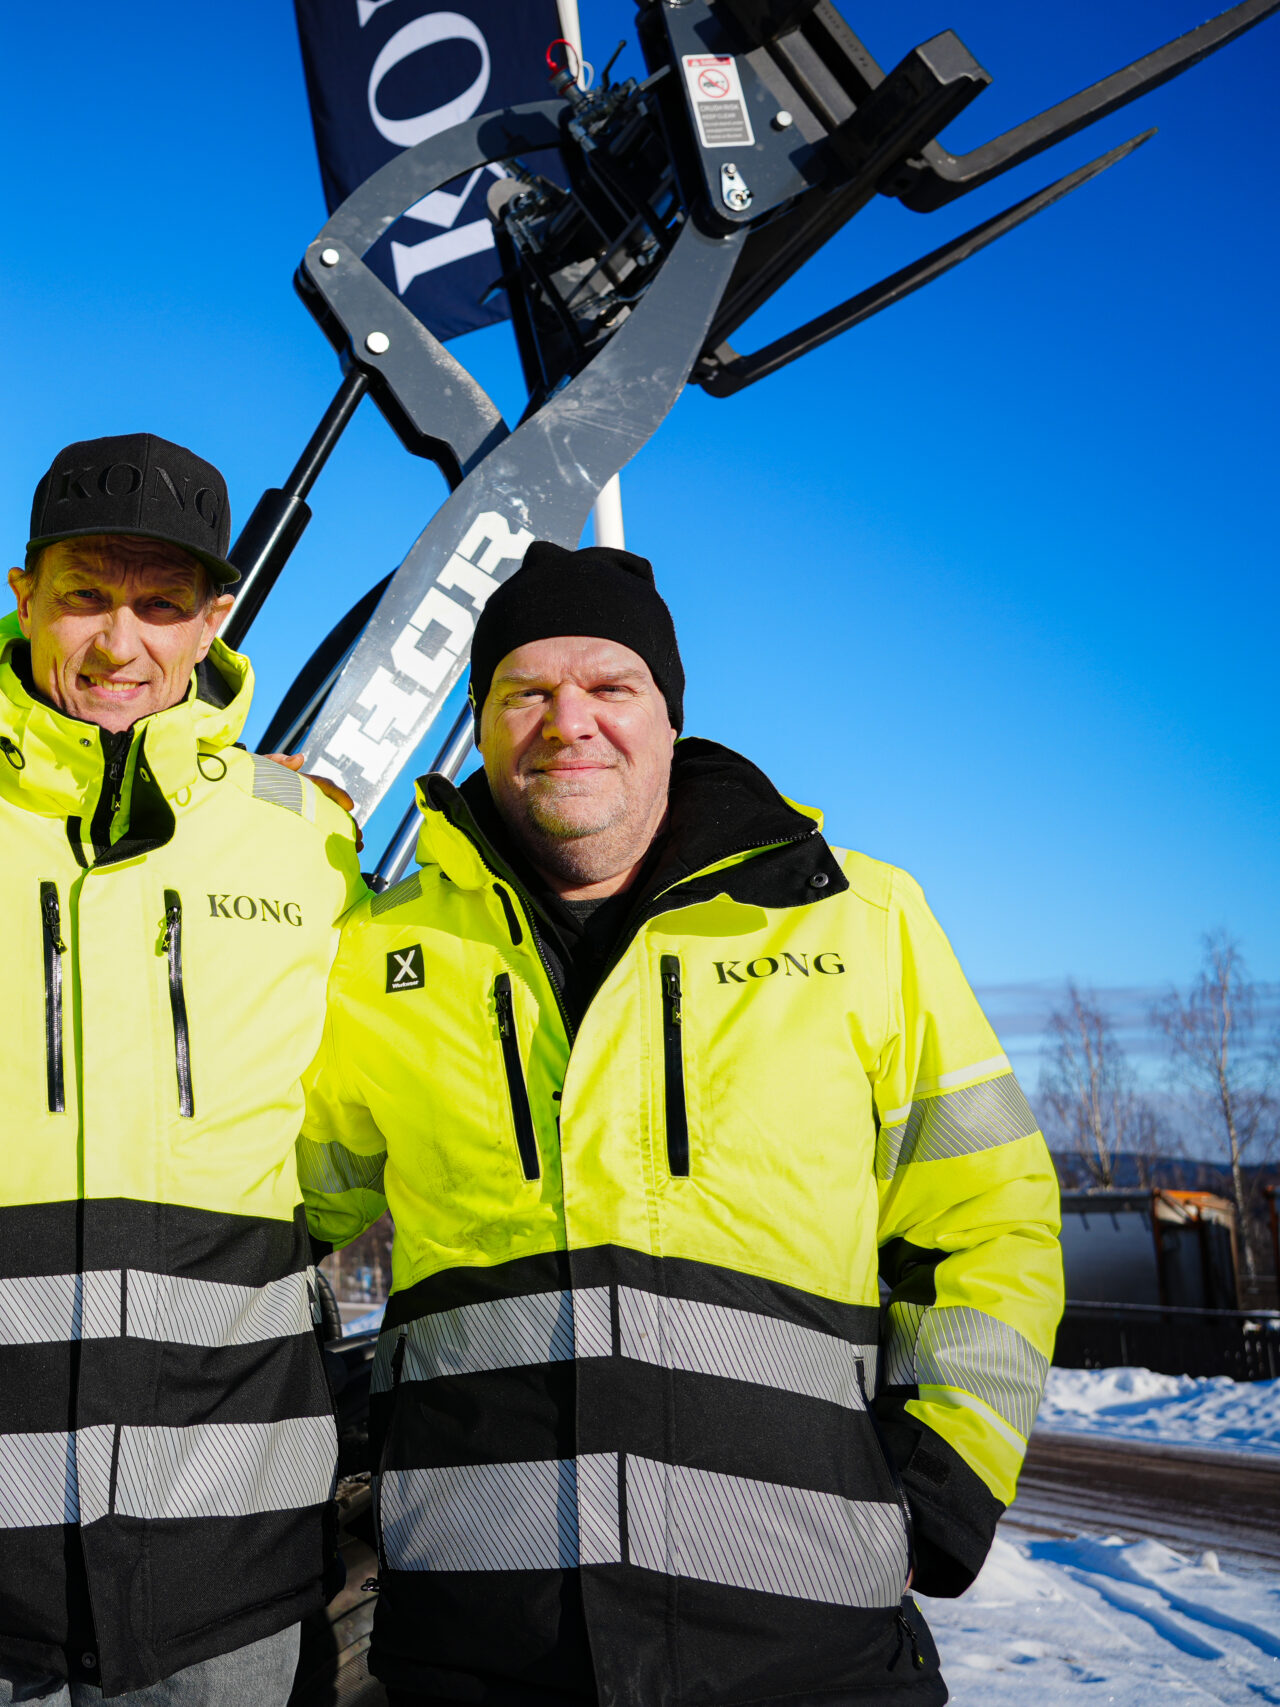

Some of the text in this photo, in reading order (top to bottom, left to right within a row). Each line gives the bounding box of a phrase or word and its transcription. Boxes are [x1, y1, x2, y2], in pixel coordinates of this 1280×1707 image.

[58, 463, 220, 529] KONG
[308, 511, 536, 815] HOR
[206, 894, 303, 927] KONG
[393, 949, 418, 982] X
[712, 952, 846, 984] KONG
